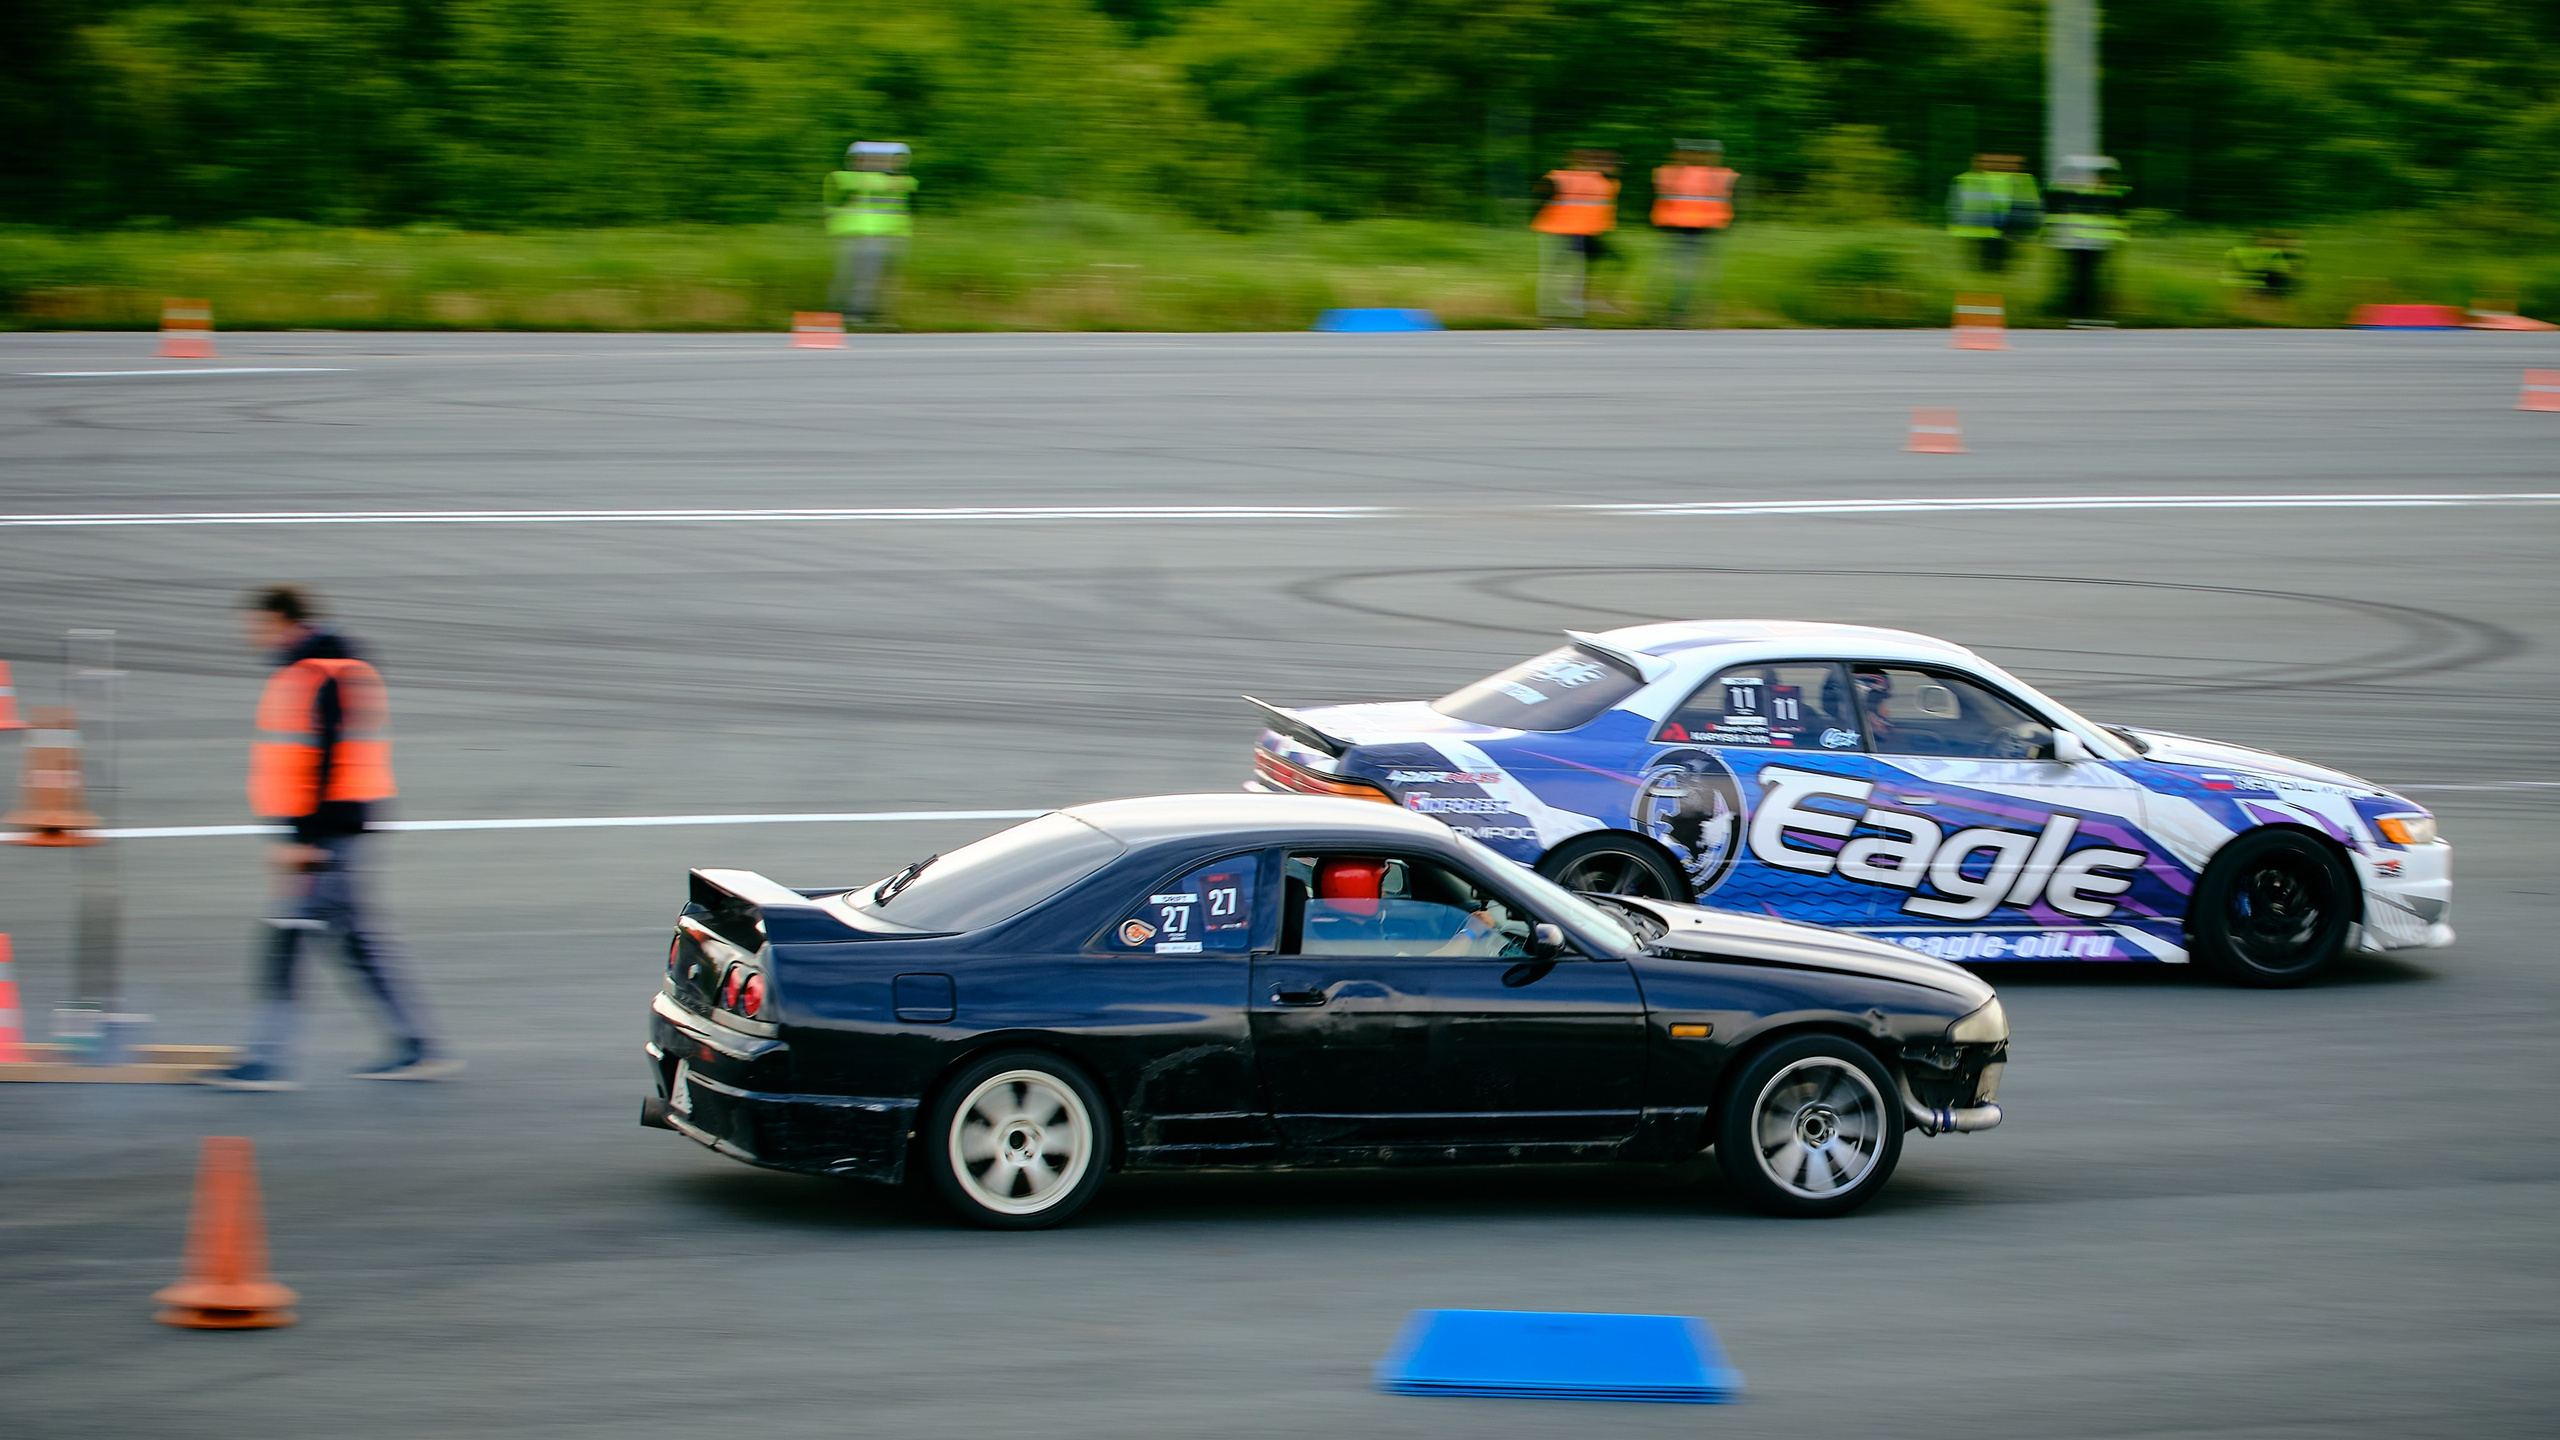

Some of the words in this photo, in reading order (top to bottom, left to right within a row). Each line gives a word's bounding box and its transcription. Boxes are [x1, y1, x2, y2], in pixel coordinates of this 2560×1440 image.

[1729, 686, 1756, 709] 11
[1772, 697, 1799, 721] 11
[1748, 765, 2148, 920] Eagle
[1208, 887, 1237, 916] 27
[1161, 905, 1190, 932] 27
